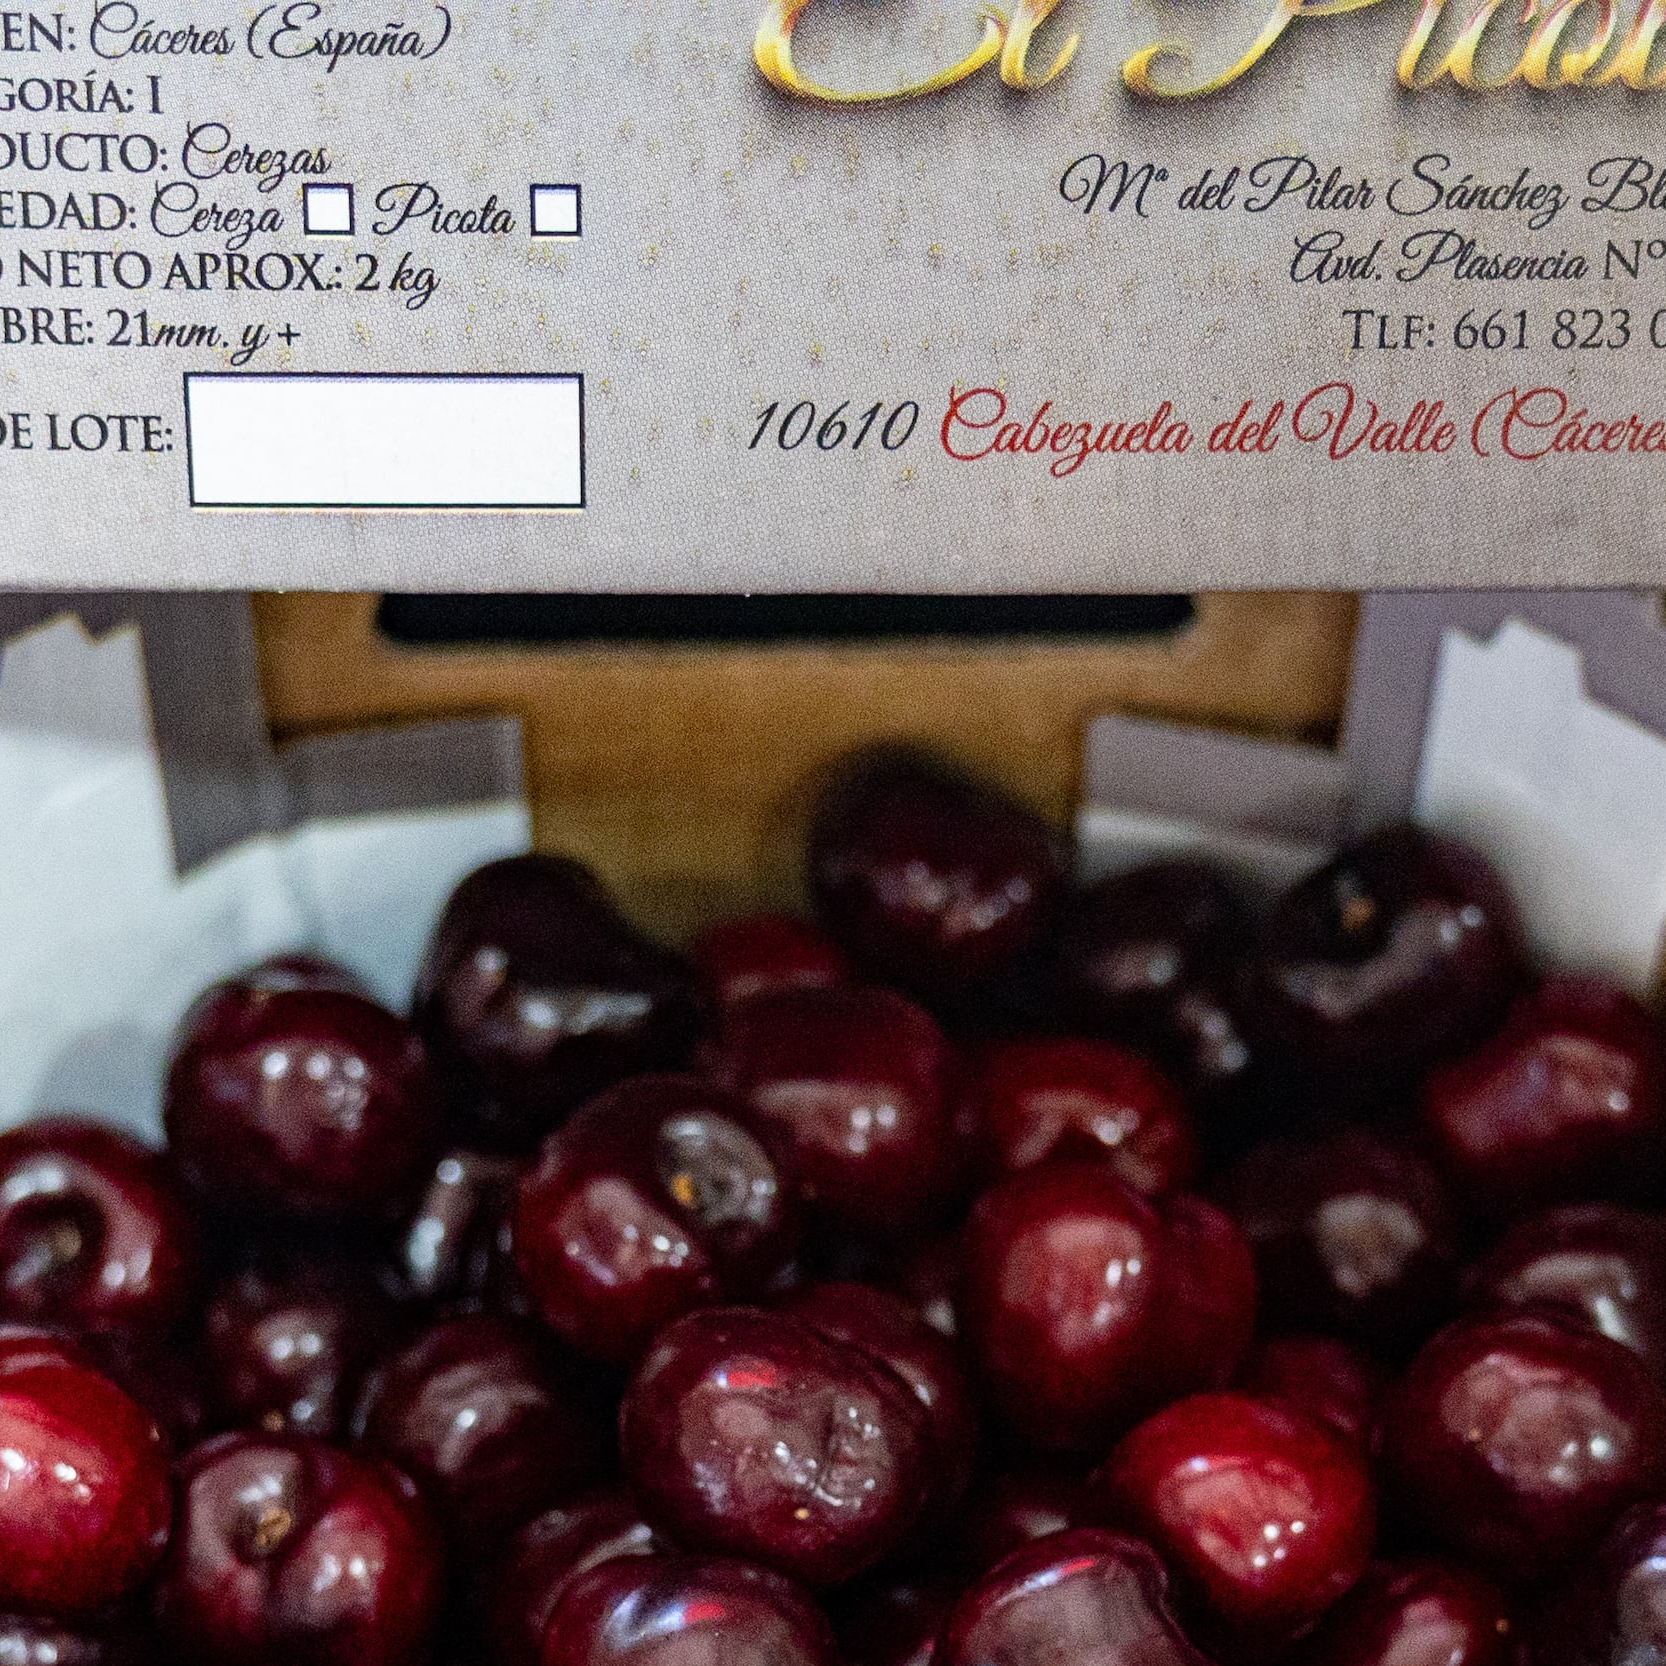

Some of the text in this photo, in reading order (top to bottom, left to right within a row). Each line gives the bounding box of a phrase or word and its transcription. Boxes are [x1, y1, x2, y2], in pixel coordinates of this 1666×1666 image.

[90, 0, 234, 59] Cáceres
[247, 4, 452, 73] (España)
[145, 75, 164, 114] I
[181, 121, 331, 193] Cerezas
[150, 179, 284, 250] Cereza
[371, 183, 517, 238] Picota
[1177, 165, 1236, 215] del
[1244, 156, 1376, 216] Pilar
[1387, 153, 1571, 230] Sánchez
[18, 250, 151, 290] NETO
[164, 252, 344, 292] APROX.:
[1290, 232, 1384, 286] Avd.
[1397, 230, 1589, 286] Plasencia
[1452, 309, 1531, 352] 661
[1551, 309, 1632, 352] 823
[47, 413, 174, 453] LOTE:
[747, 399, 919, 454] 10610
[939, 385, 1194, 479] Cabezuela
[1208, 398, 1283, 455] del
[1292, 381, 1457, 459] Valle
